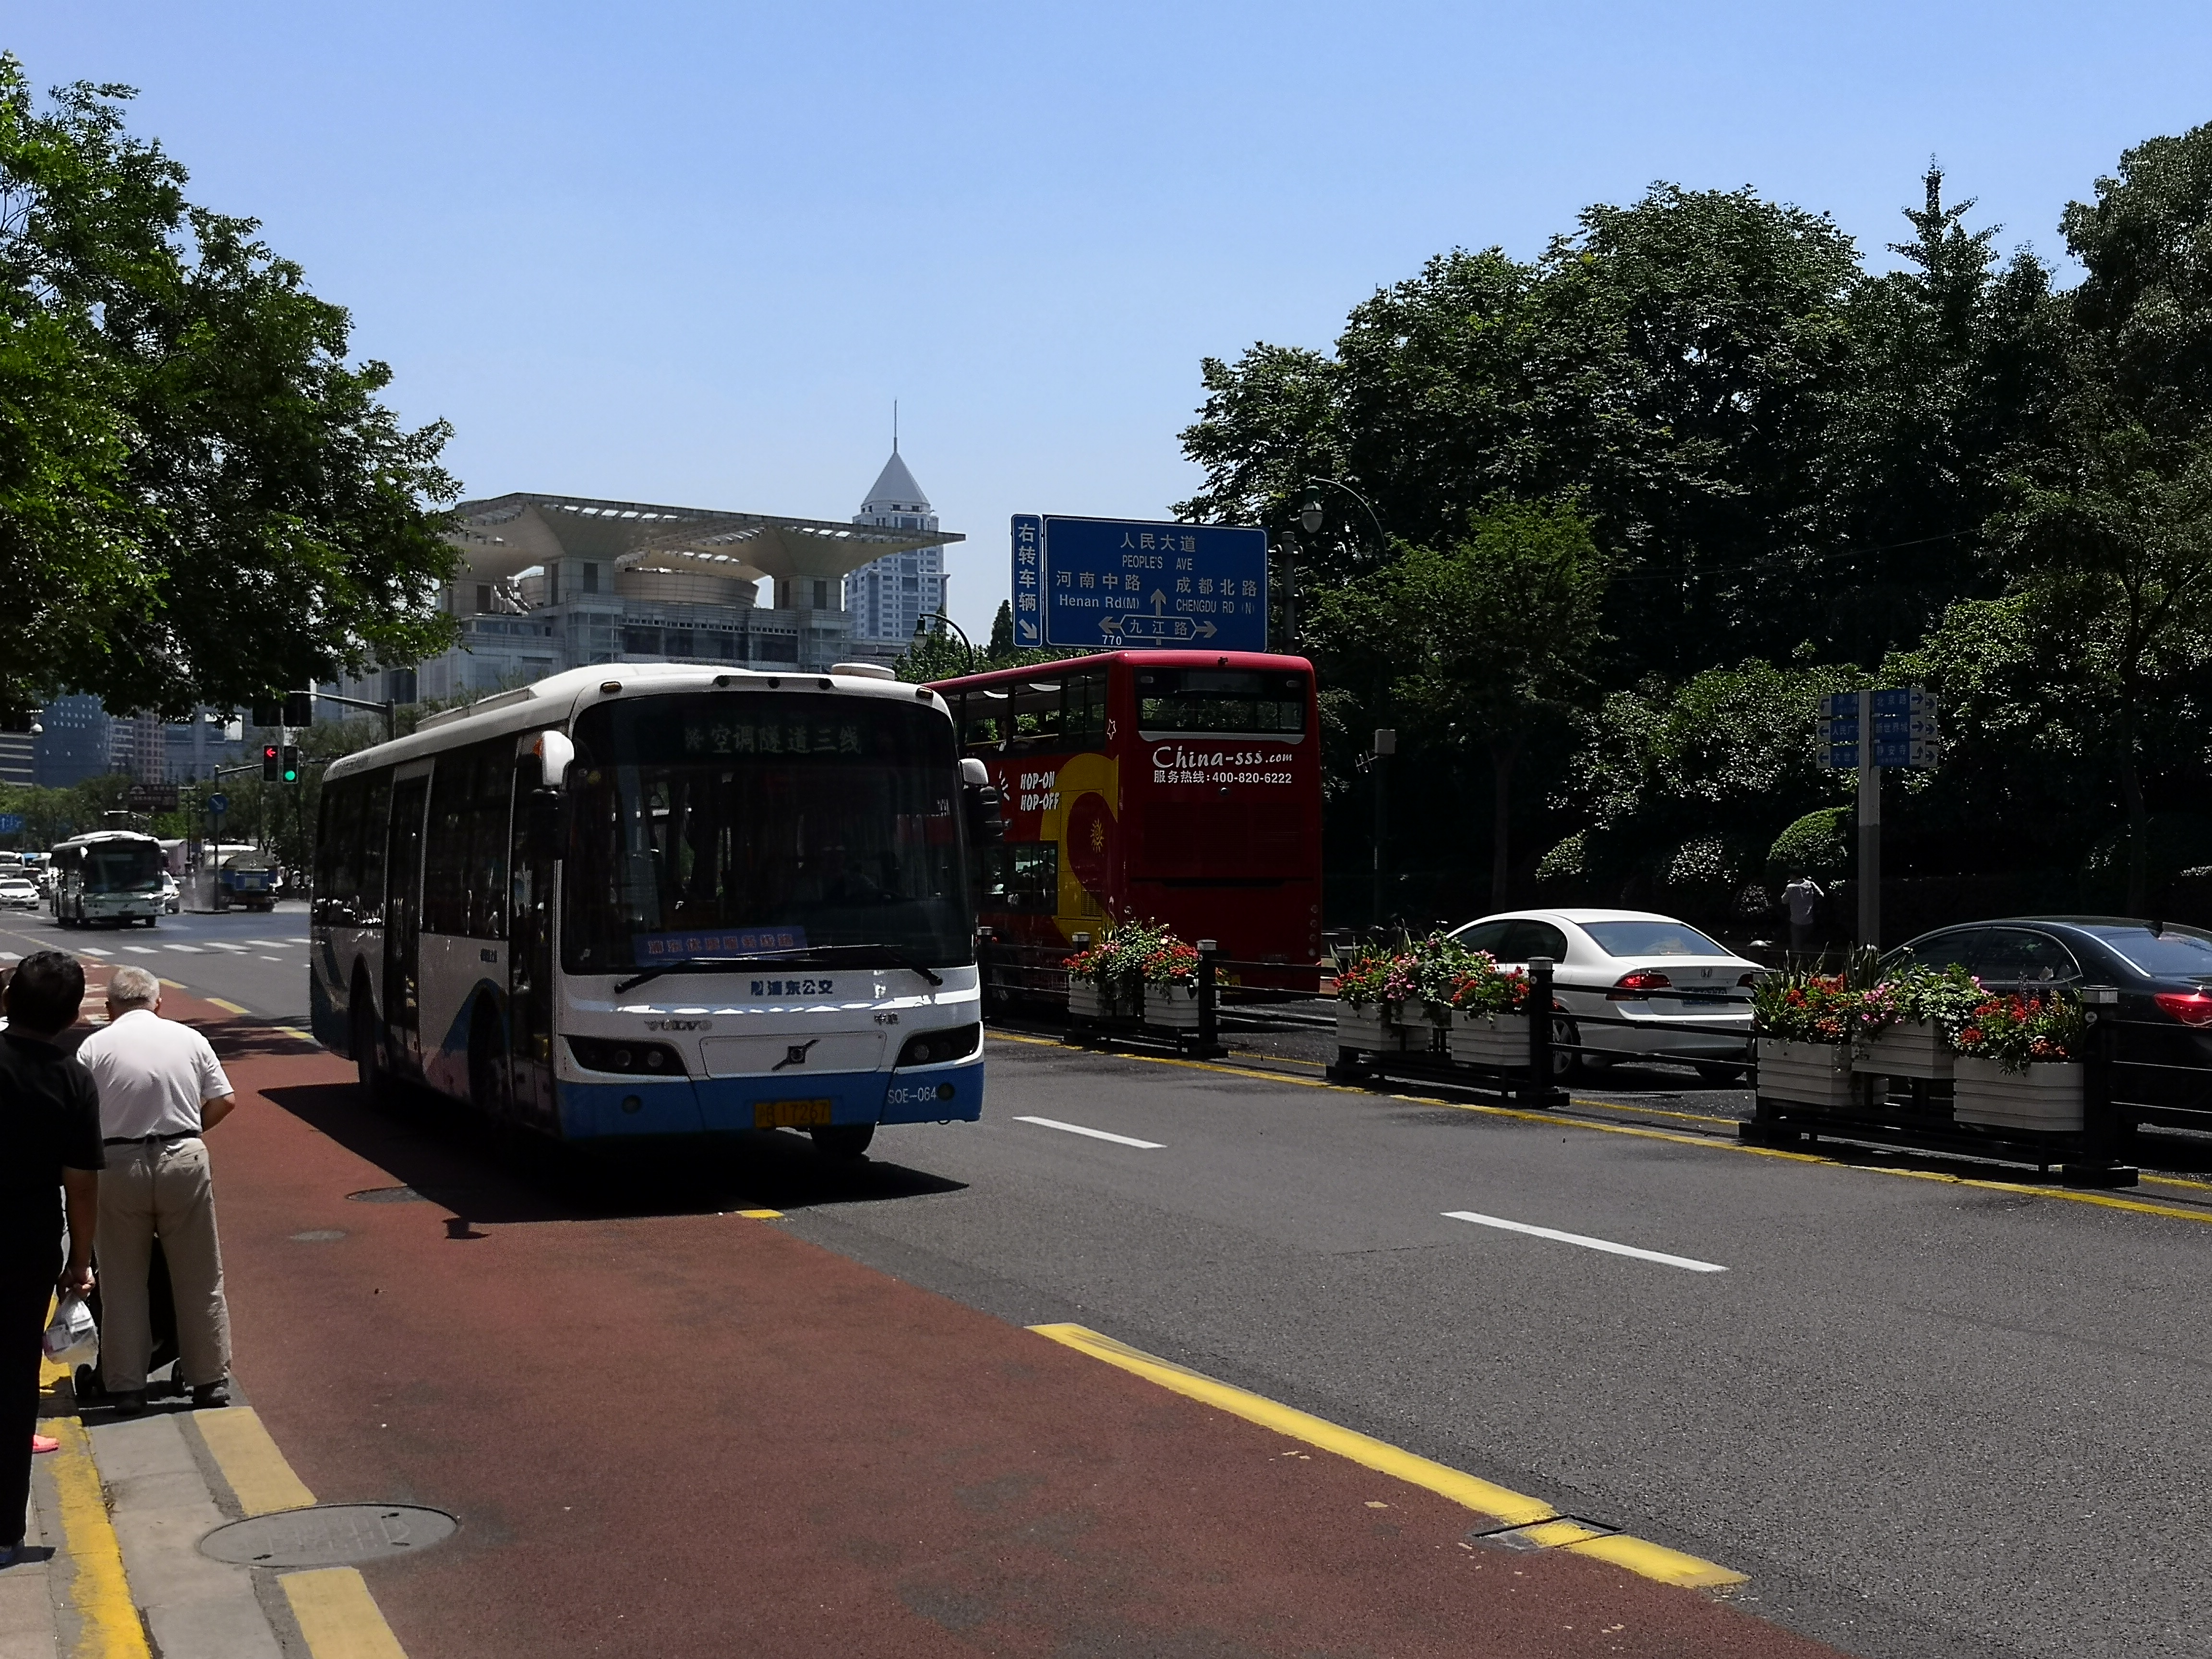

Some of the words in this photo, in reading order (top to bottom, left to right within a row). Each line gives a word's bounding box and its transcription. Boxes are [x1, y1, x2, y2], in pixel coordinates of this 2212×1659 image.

[1120, 532, 1196, 553] 人民大道
[1018, 523, 1036, 612] 右转车辆
[1122, 554, 1163, 569] PEOPLE'S
[1176, 557, 1193, 571] AVE
[1056, 570, 1141, 591] 河南中路
[1176, 577, 1257, 597] 成都北路
[1059, 594, 1099, 608] Henan
[1176, 599, 1216, 613] CHENGDU
[1222, 601, 1234, 614] RD
[1130, 619, 1188, 636] 九江路
[1102, 635, 1122, 646] 770
[1876, 694, 1906, 707] 北京路
[1875, 722, 1908, 733] 新世界城
[1153, 746, 1293, 769] China-sss.com
[1876, 744, 1906, 756] 静安寺
[1020, 771, 1055, 790] HOP-ON
[1021, 792, 1060, 811] HOP-OFF
[888, 1086, 937, 1104] SOE-064
